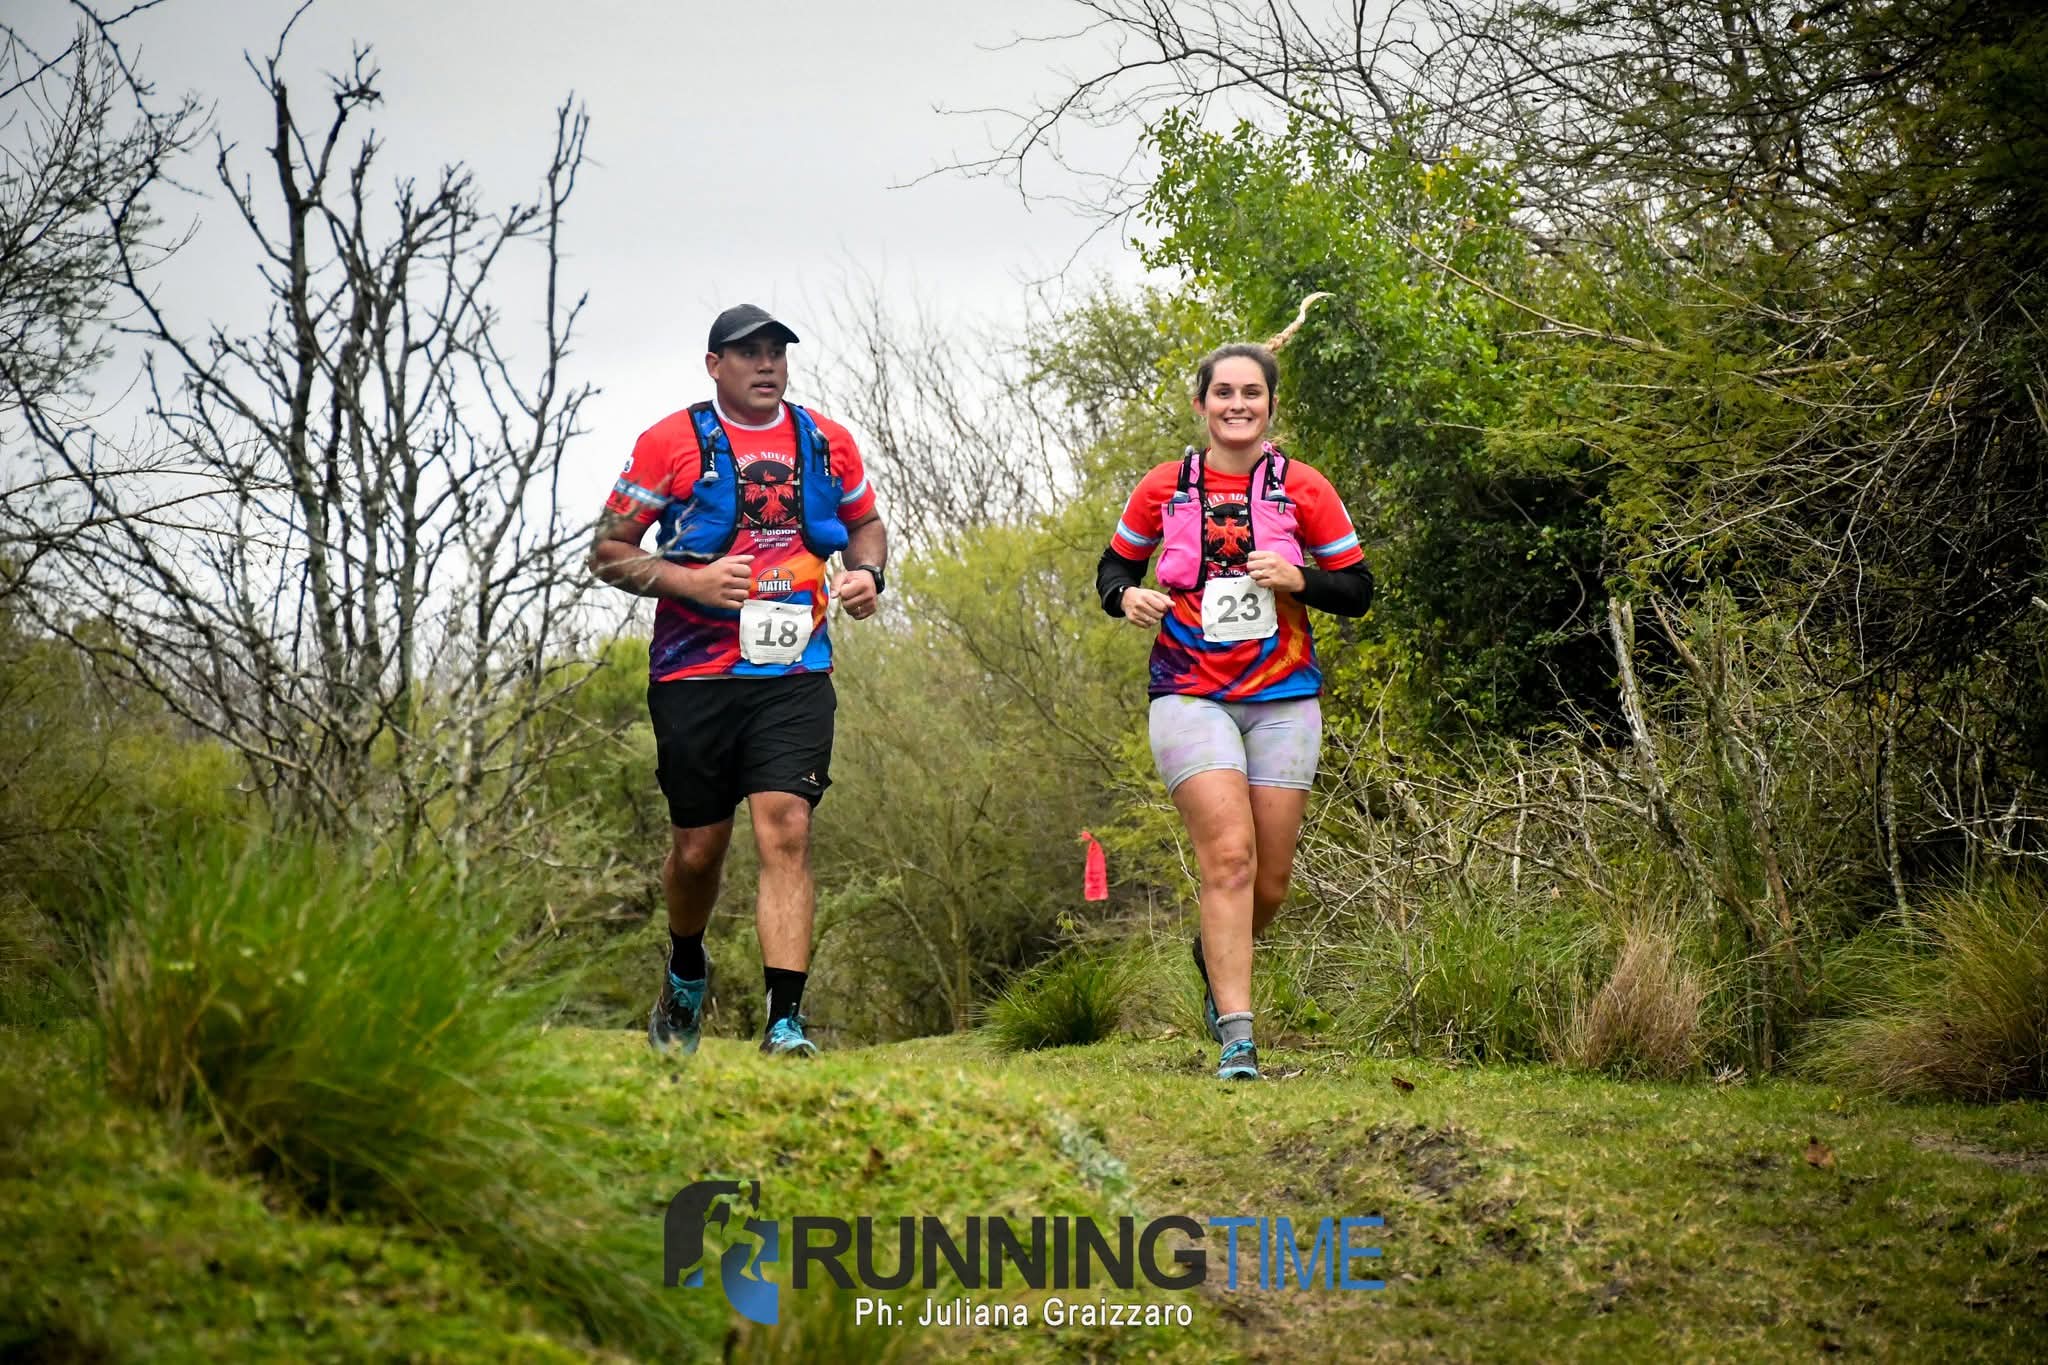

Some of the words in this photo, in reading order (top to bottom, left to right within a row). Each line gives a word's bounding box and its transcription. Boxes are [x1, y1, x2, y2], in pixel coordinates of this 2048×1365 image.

[758, 580, 792, 592] MATIEL
[1217, 593, 1262, 623] 23
[755, 618, 798, 648] 18
